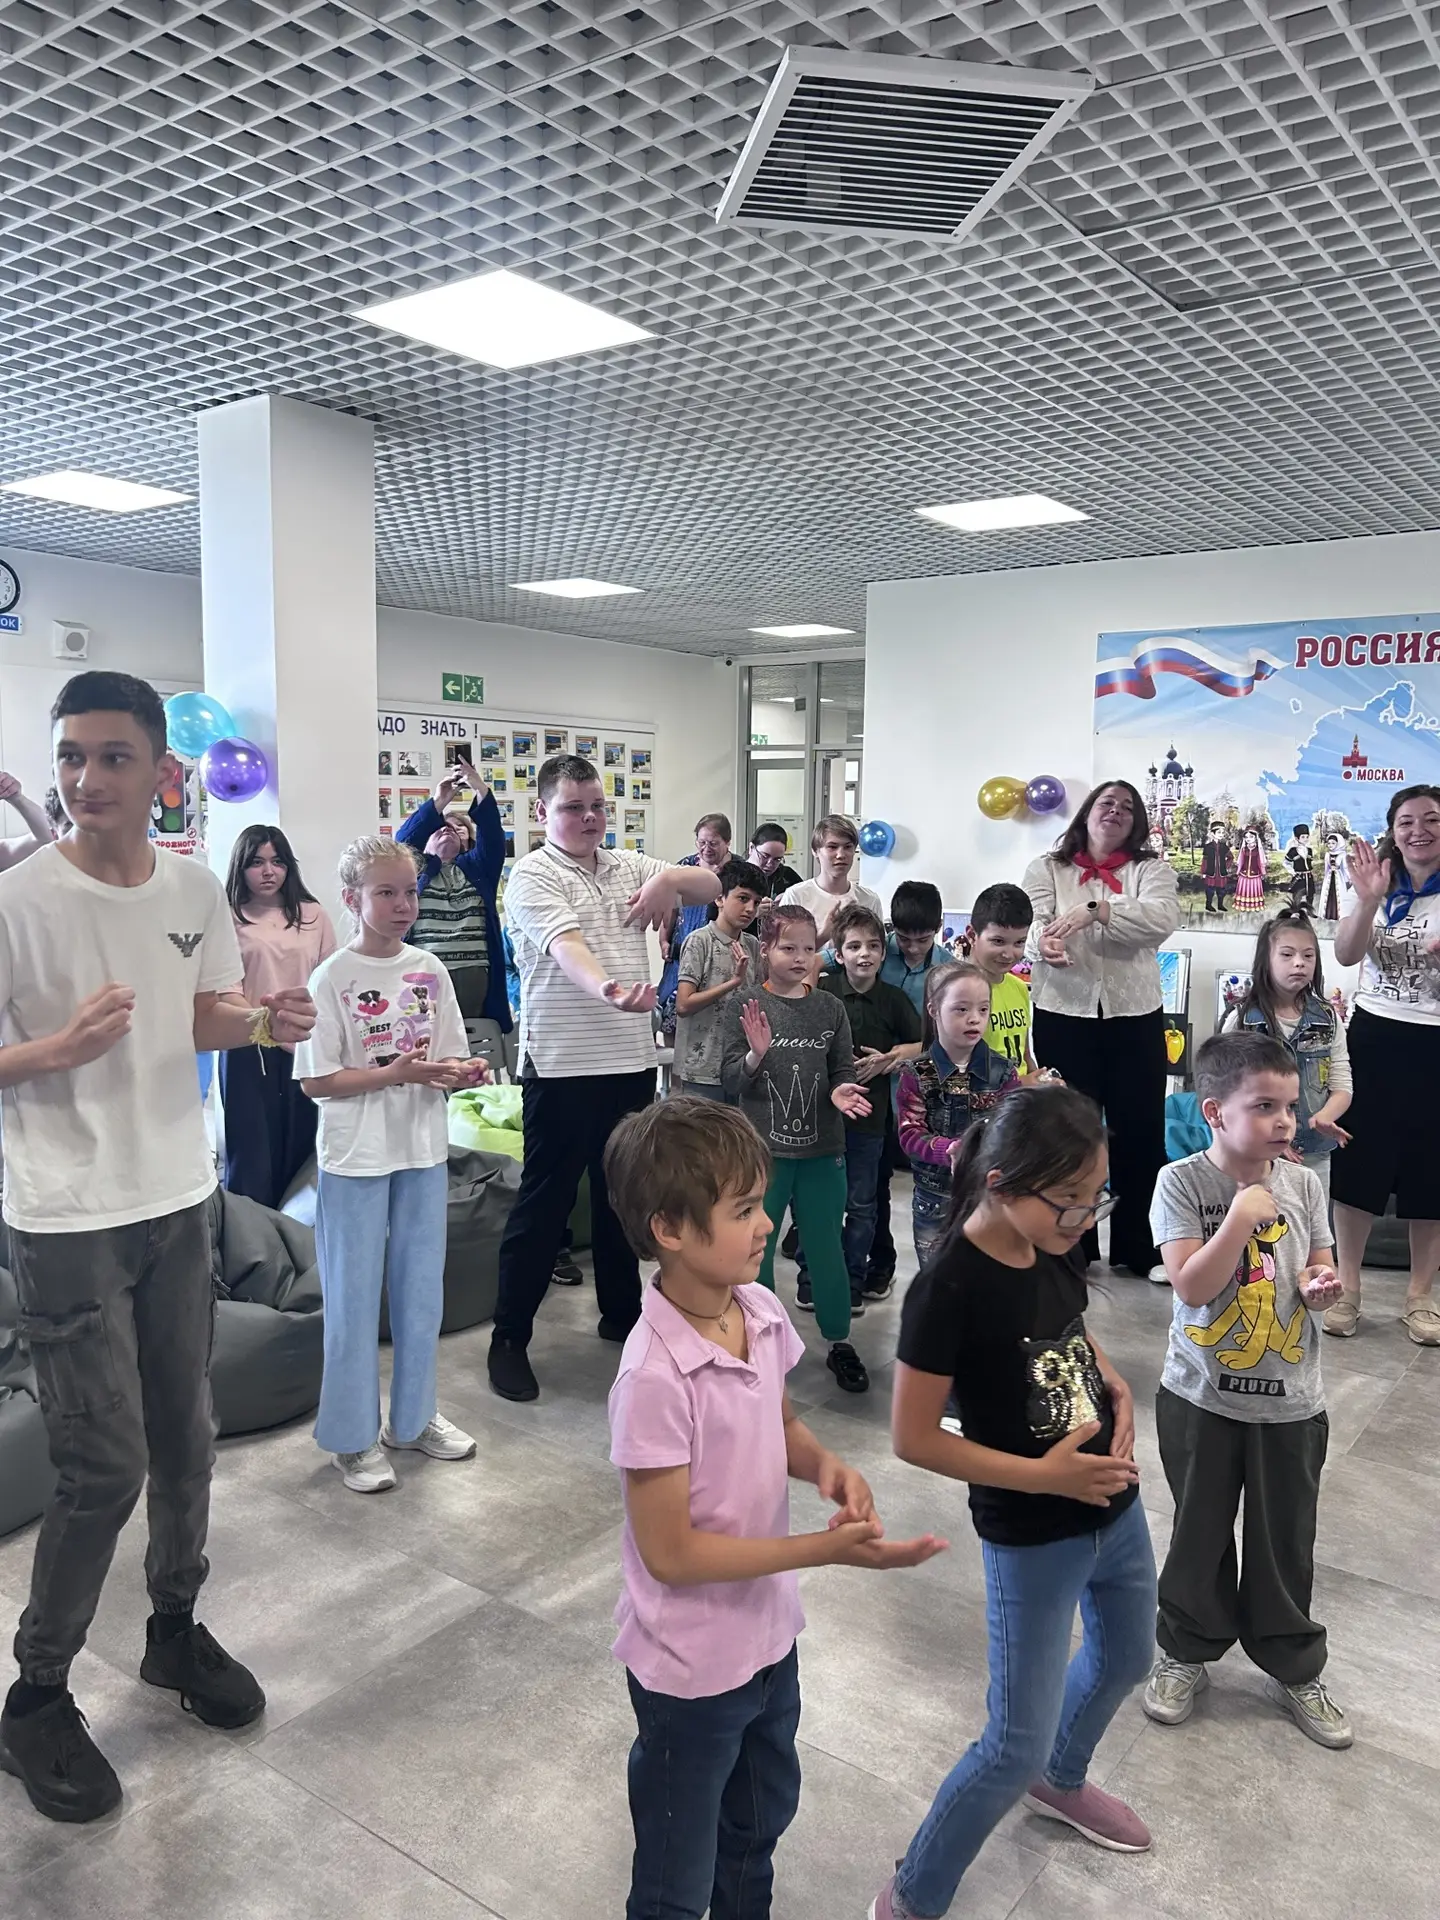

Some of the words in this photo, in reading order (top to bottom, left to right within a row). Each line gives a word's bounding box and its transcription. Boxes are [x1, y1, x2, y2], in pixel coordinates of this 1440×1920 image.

[0, 617, 16, 628] ОК
[1295, 630, 1440, 668] РОССИЯ
[378, 716, 406, 735] ДО
[420, 719, 467, 738] ЗНАТЬ
[1356, 768, 1405, 781] МОСКВА
[369, 1022, 391, 1034] BEST
[990, 1008, 1027, 1032] PAUSE
[768, 1030, 835, 1049] incesS
[1228, 1376, 1280, 1395] PLUTO
